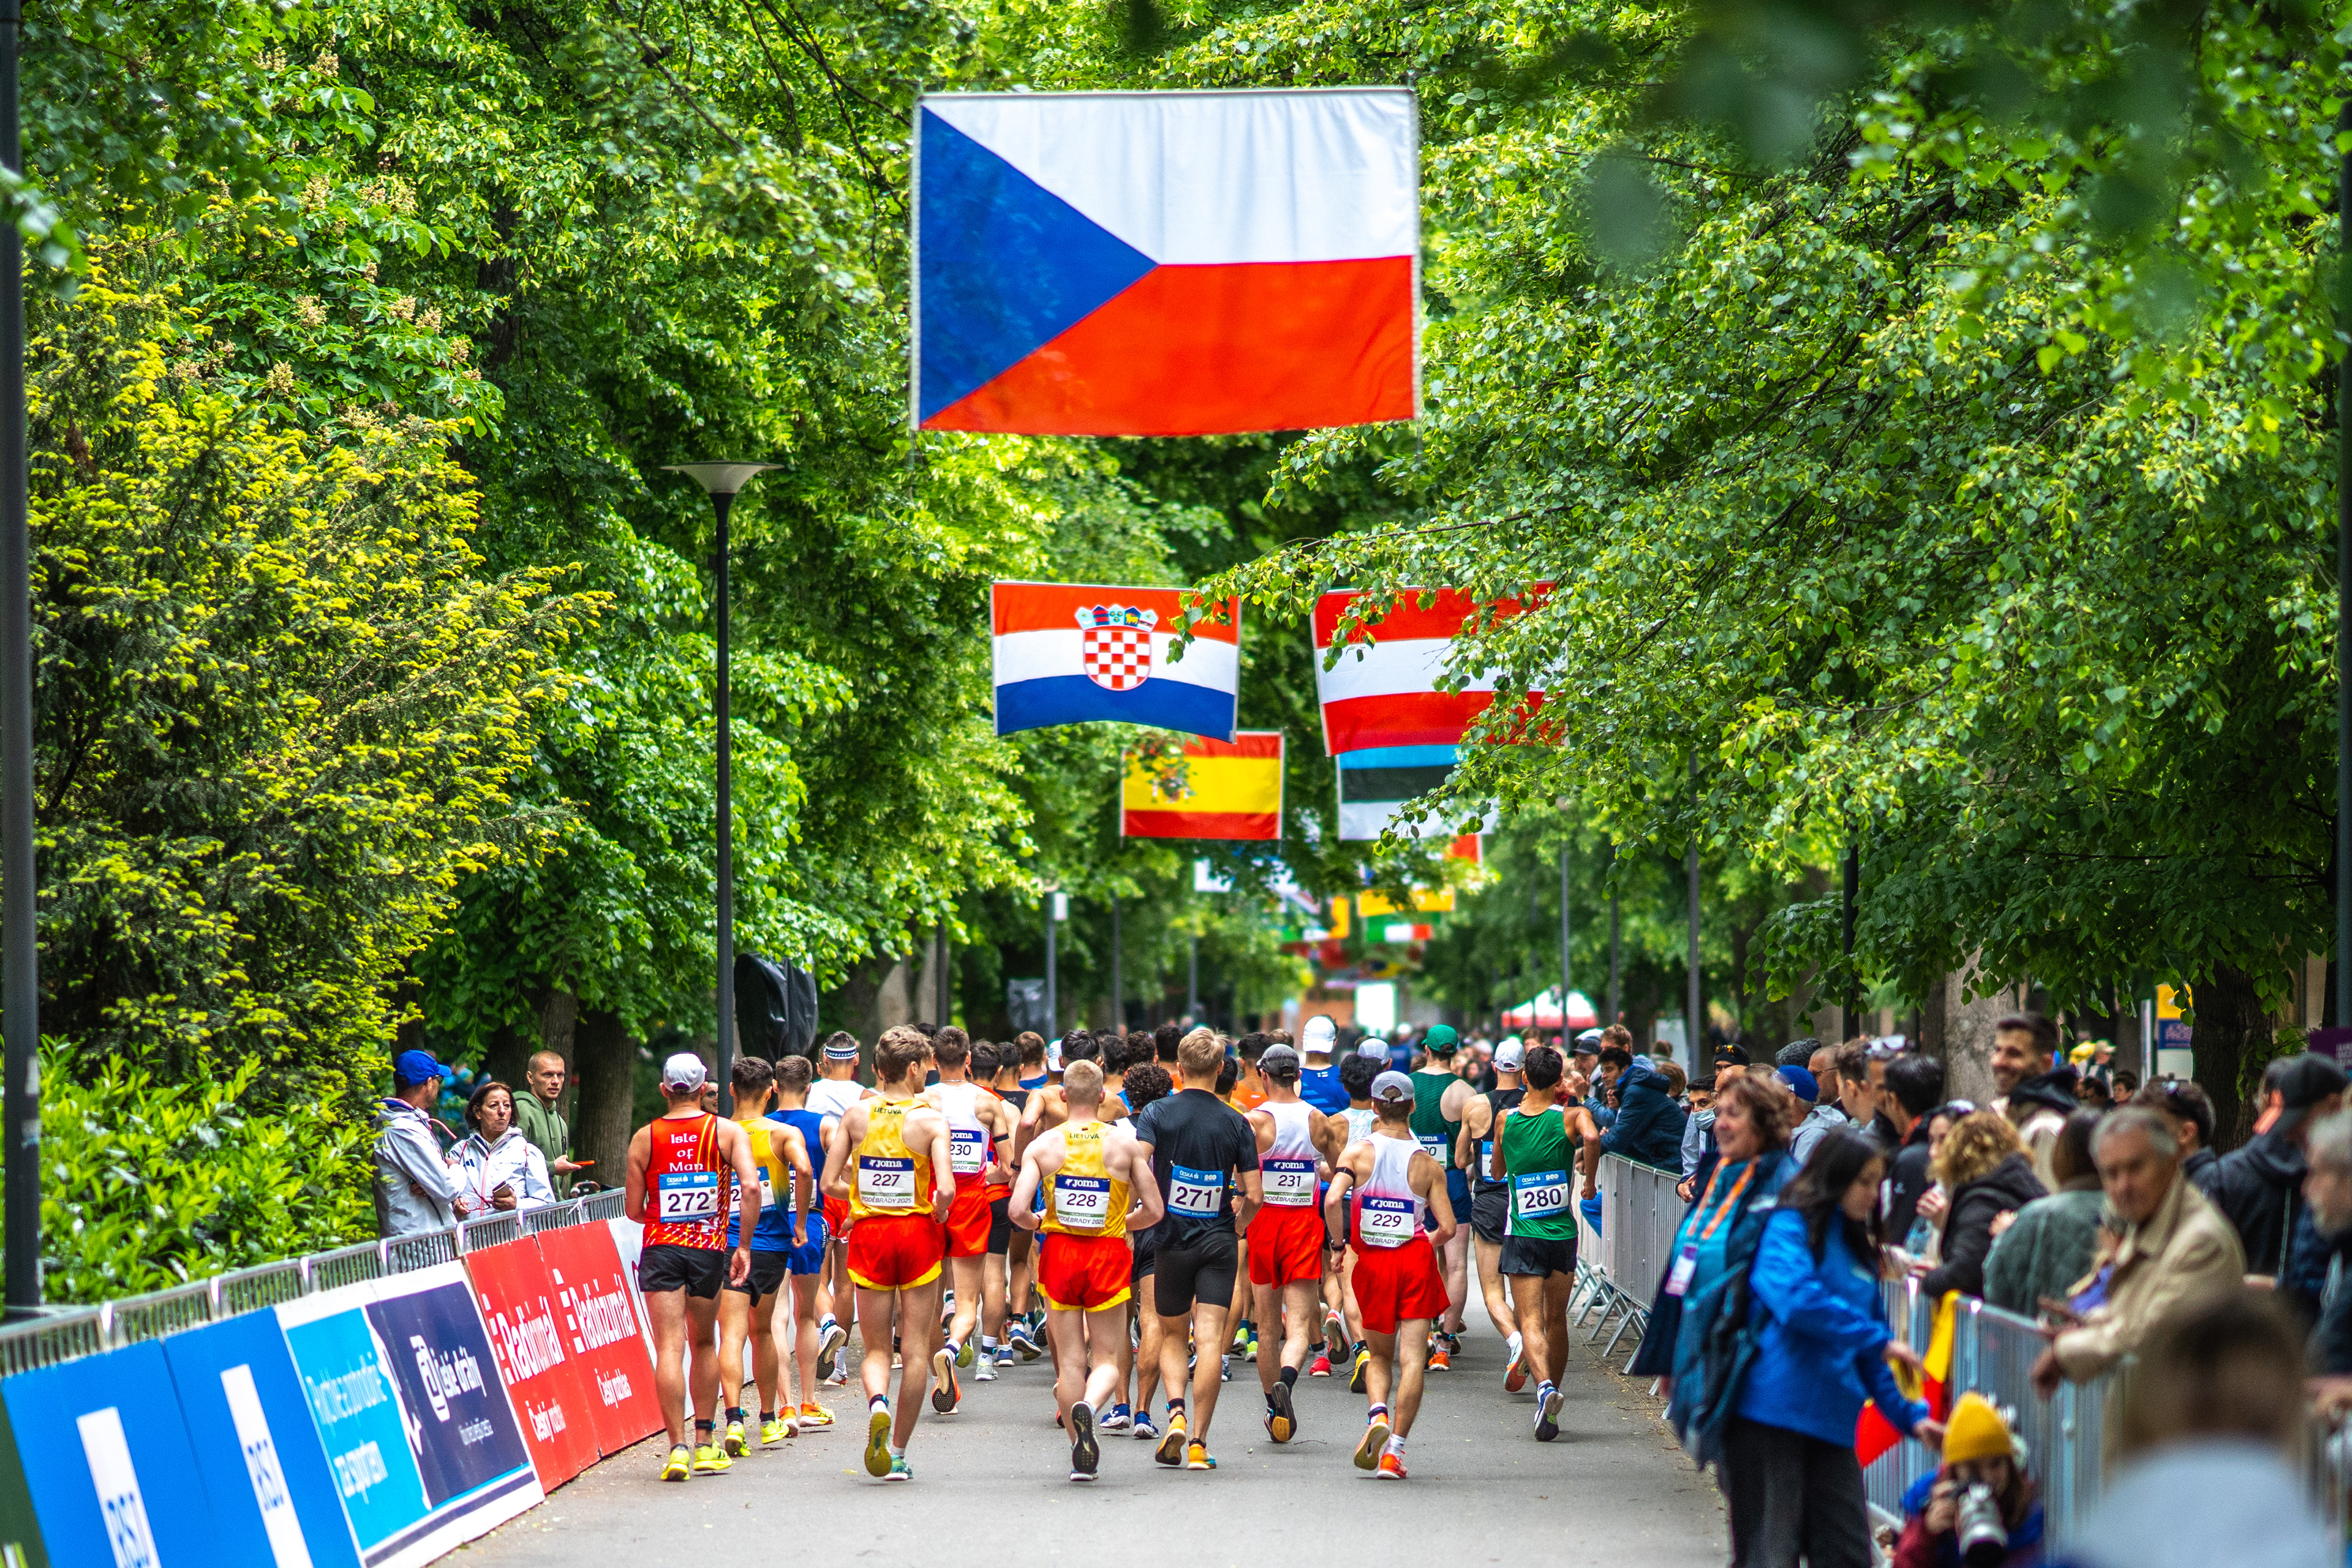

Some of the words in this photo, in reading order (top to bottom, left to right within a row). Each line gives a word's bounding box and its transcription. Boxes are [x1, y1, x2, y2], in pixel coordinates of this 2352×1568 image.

[671, 1133, 698, 1144] Isle
[677, 1148, 693, 1159] of
[950, 1144, 971, 1155] 230
[669, 1162, 704, 1172] Man
[872, 1174, 900, 1186] 227
[1278, 1175, 1301, 1187] 231
[668, 1192, 709, 1212] 272
[1066, 1193, 1097, 1207] 228
[1175, 1186, 1212, 1208] 271
[1524, 1188, 1561, 1209] 280
[1372, 1213, 1401, 1227] 229
[568, 1273, 637, 1351] Radiožurnál
